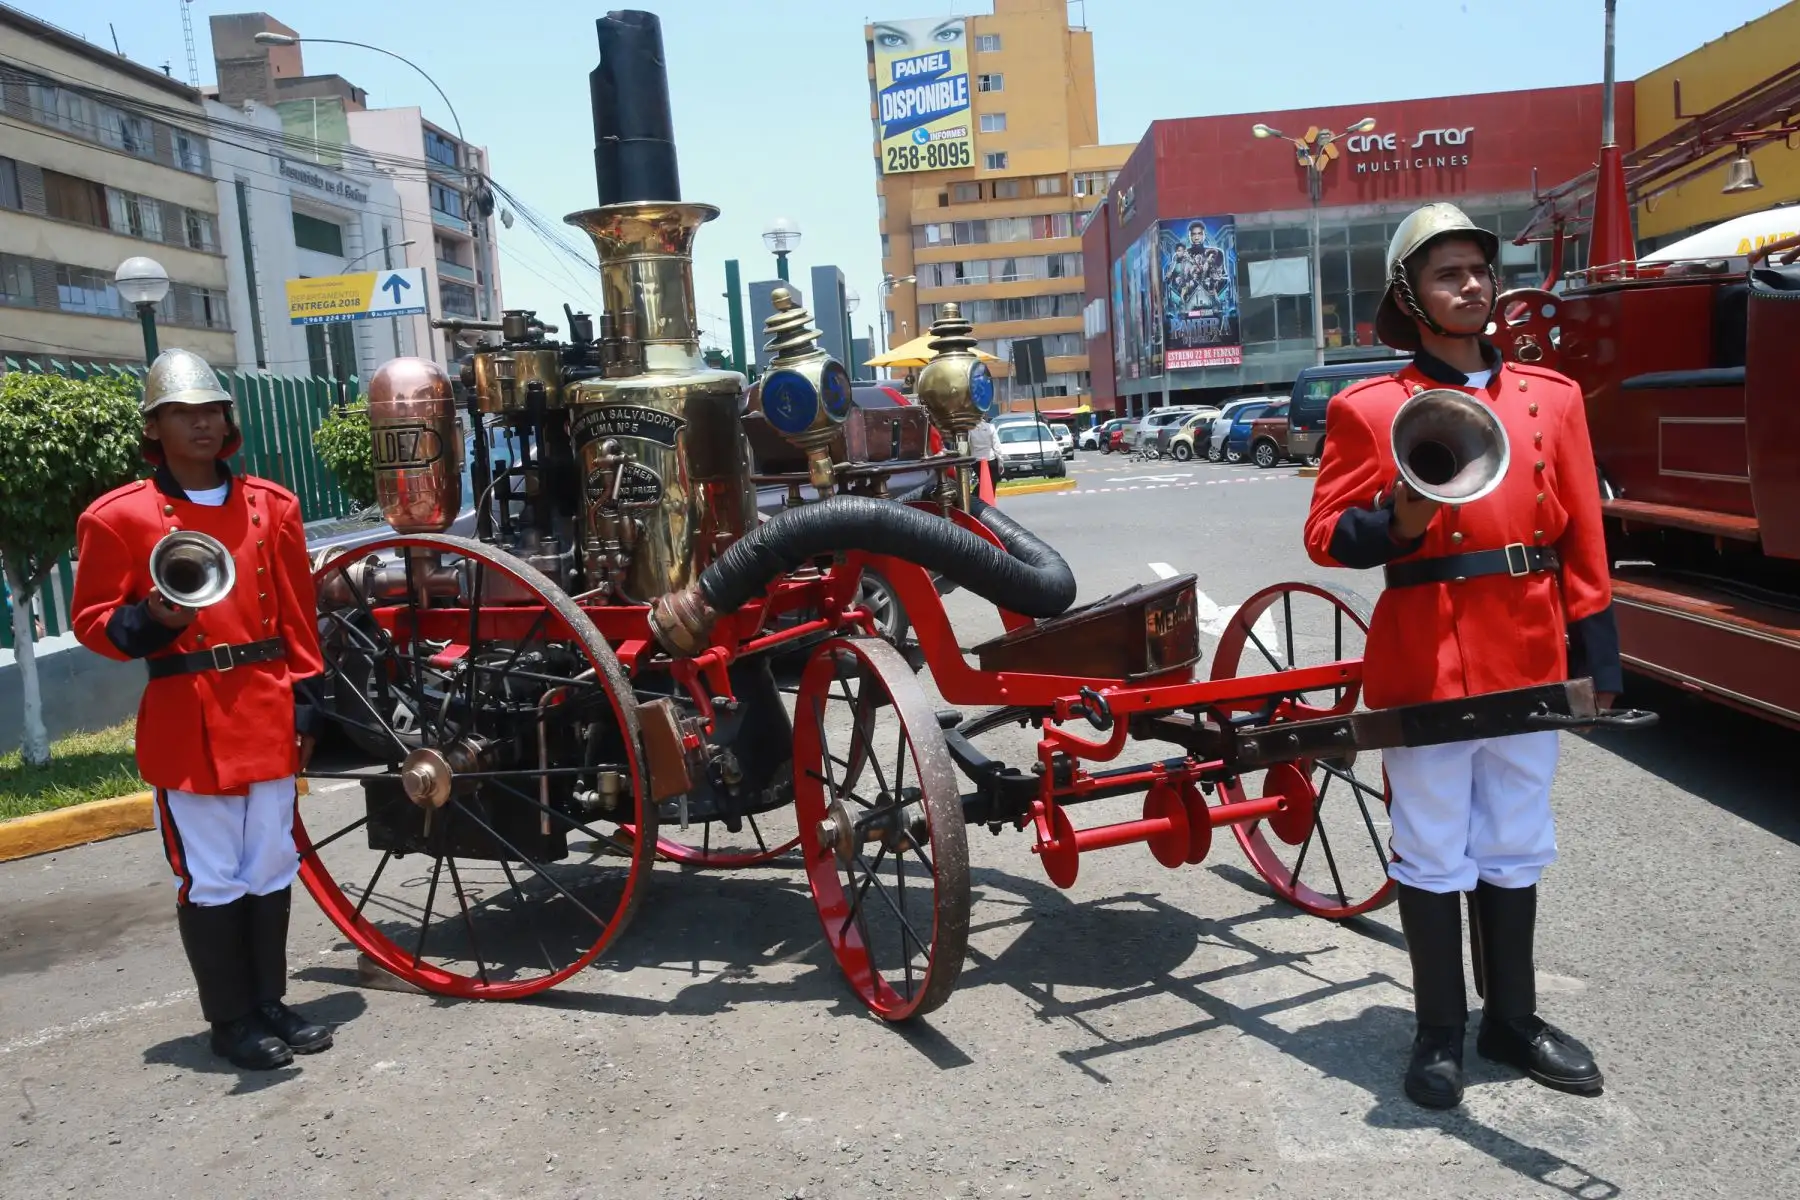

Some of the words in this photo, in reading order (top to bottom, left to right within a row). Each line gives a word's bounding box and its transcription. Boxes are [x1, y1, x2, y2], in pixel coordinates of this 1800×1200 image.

[895, 53, 948, 79] PANEL
[882, 77, 968, 122] DISPONIBLE
[930, 127, 966, 141] INFORMES
[887, 141, 970, 171] 258-8095
[1357, 155, 1469, 173] MULTICINES
[290, 290, 360, 303] DEPARTAMENTOS
[291, 300, 337, 312] ENTREGA
[339, 298, 361, 308] 2018
[1167, 350, 1194, 361] ESTRENO
[609, 408, 676, 430] SALVADORA
[590, 422, 613, 436] LIMA
[631, 423, 639, 433] 5
[633, 485, 657, 495] PRIZE
